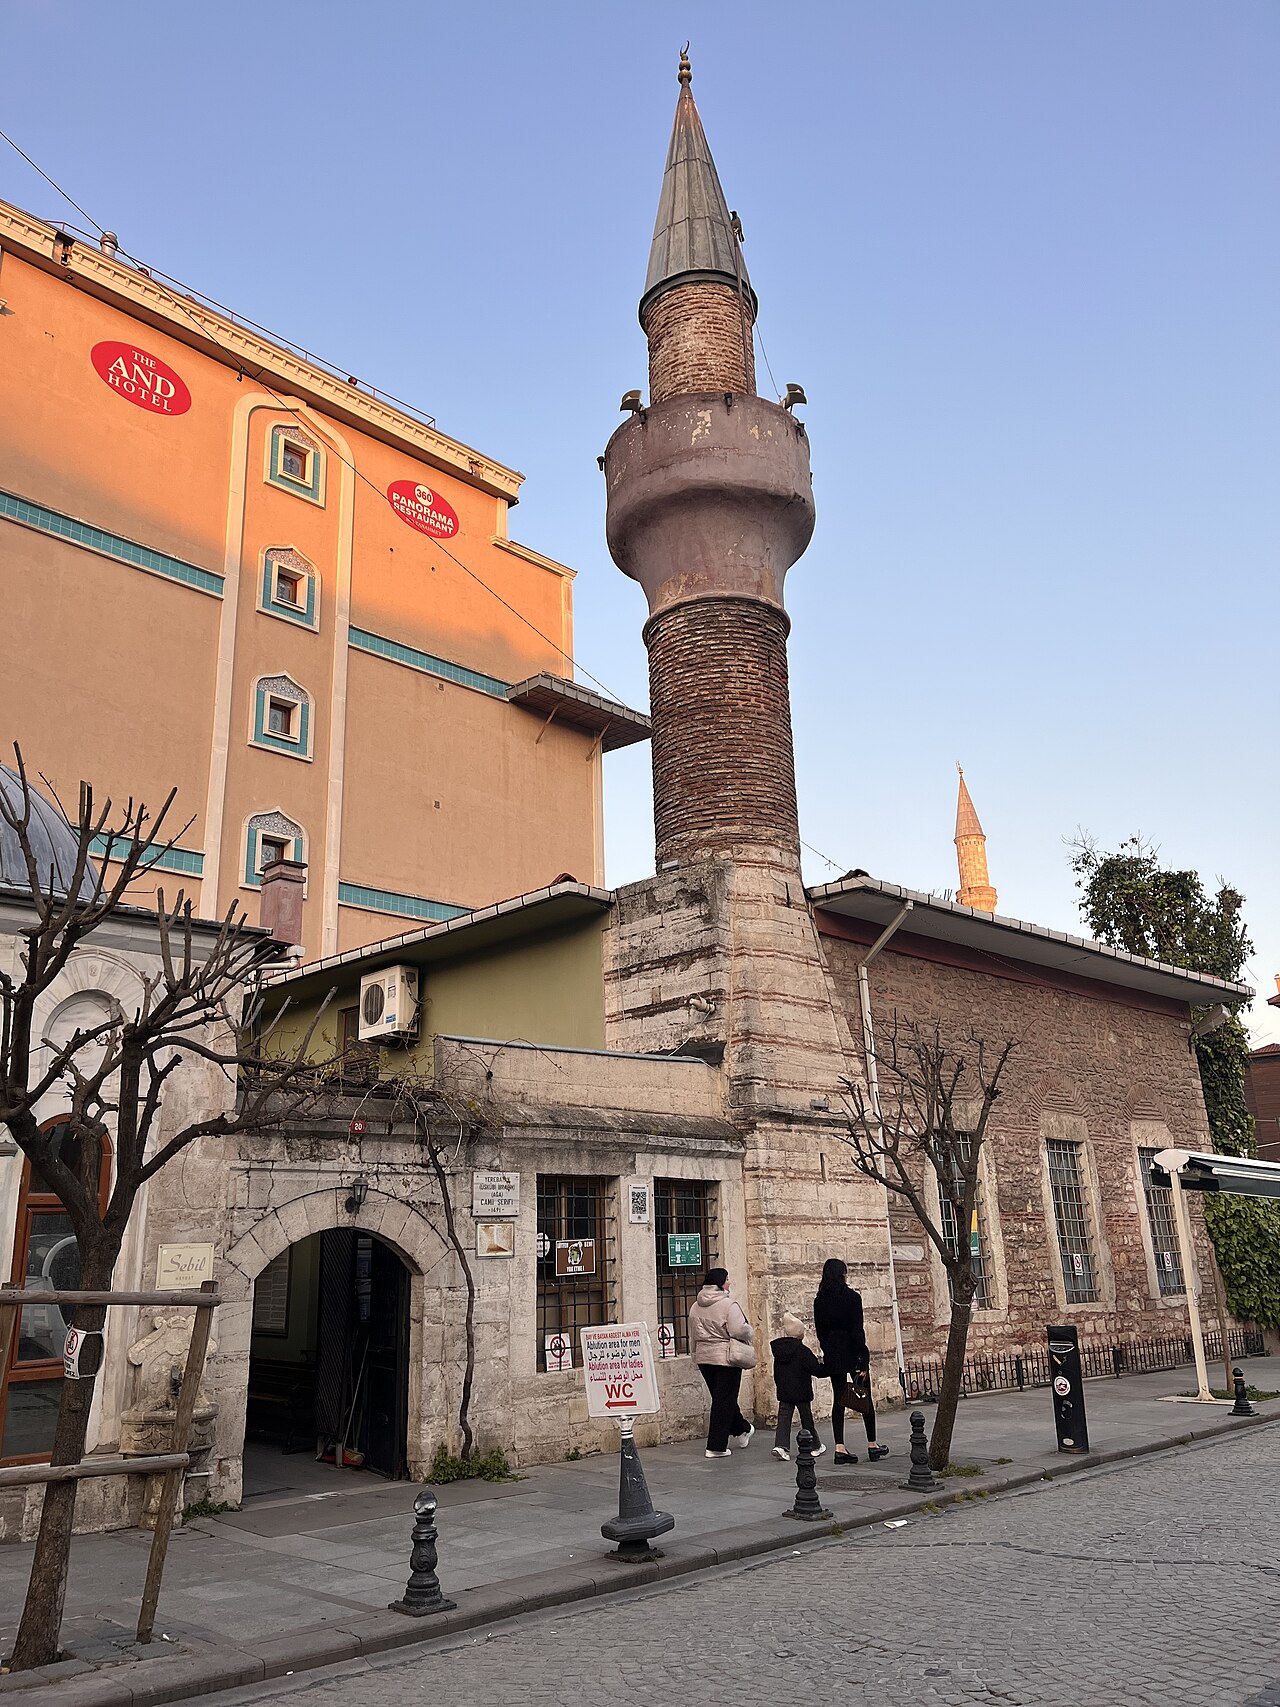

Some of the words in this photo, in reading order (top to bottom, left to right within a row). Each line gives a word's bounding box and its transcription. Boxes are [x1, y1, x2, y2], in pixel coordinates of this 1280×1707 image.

[132, 350, 157, 369] THE
[108, 356, 176, 398] AND
[107, 372, 172, 412] HOTEL
[416, 488, 432, 502] 360
[392, 492, 455, 528] PANORAMA
[393, 502, 453, 534] RESTAURANT
[355, 1122, 363, 1131] 20
[163, 1254, 206, 1272] Sebil
[586, 1341, 608, 1350] Ablution
[608, 1341, 620, 1349] area
[628, 1339, 641, 1347] men
[588, 1361, 610, 1371] Ablution
[609, 1361, 620, 1370] area
[620, 1360, 628, 1369] for
[628, 1360, 644, 1369] ladies
[604, 1383, 634, 1399] WC
